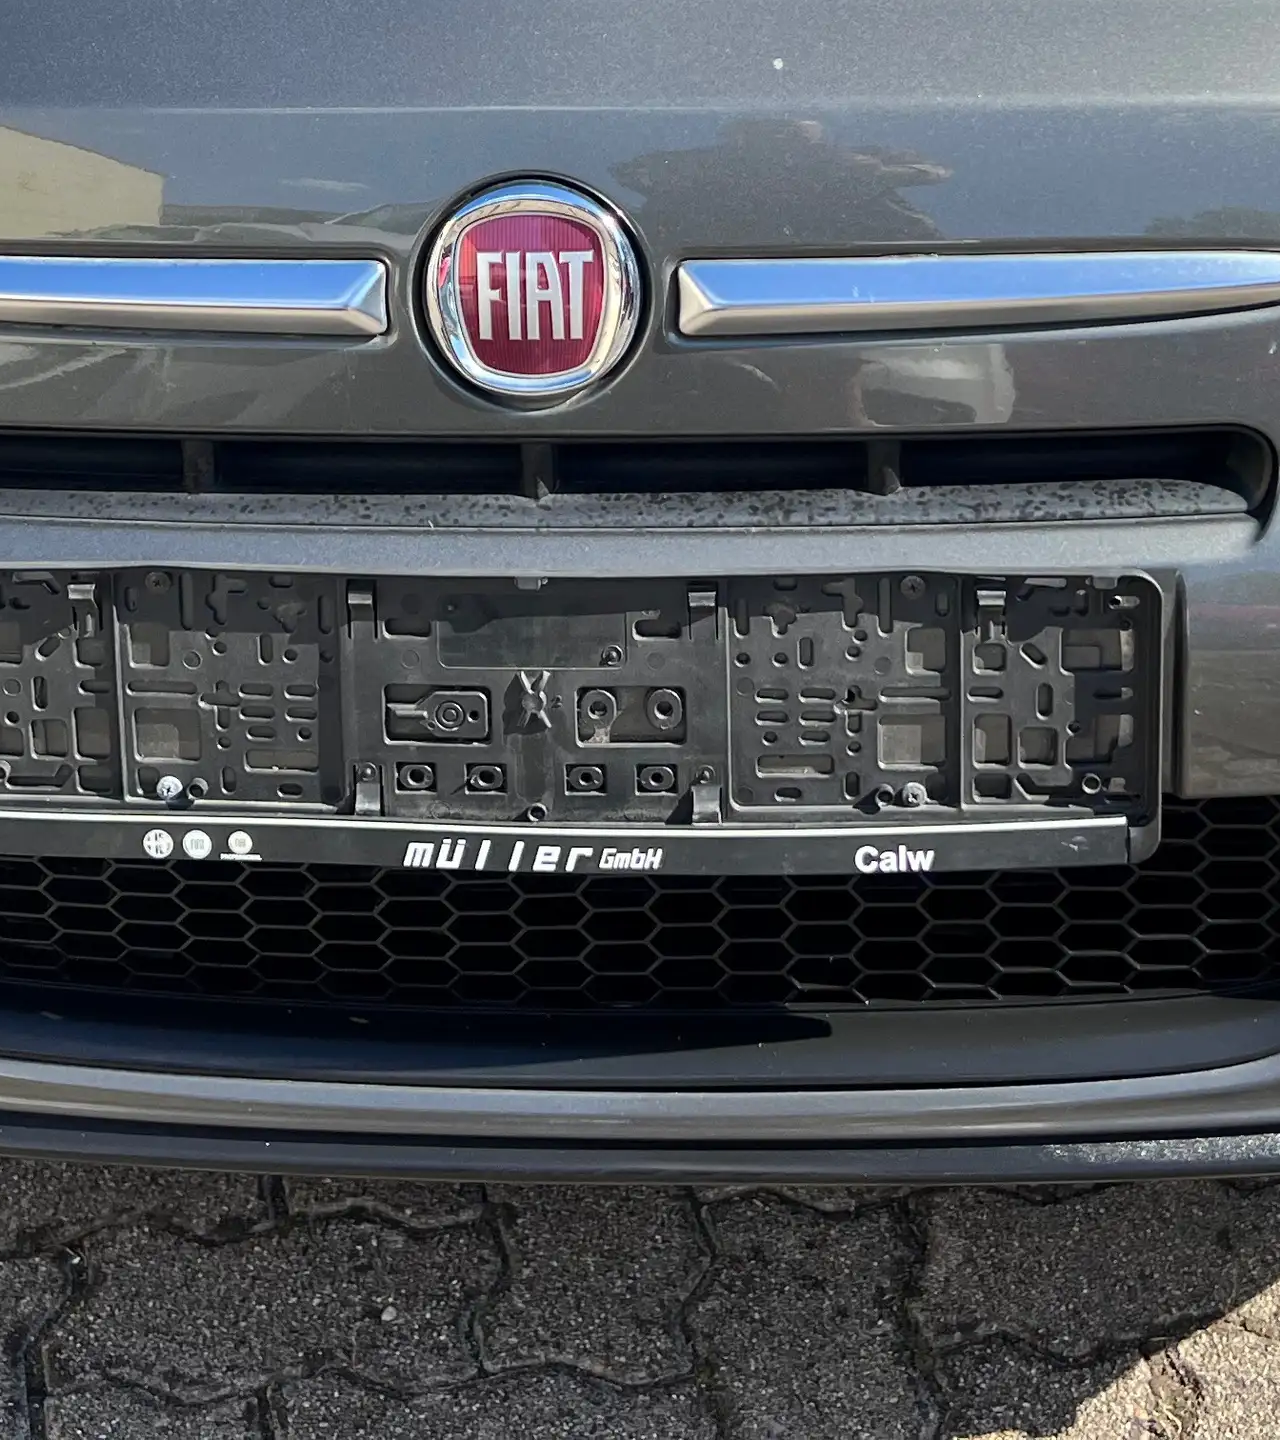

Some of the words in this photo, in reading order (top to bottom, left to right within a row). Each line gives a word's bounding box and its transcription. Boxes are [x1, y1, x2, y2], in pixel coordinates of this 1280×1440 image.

[475, 249, 595, 341] FIAT
[403, 838, 594, 872] müller
[598, 847, 663, 870] GmbH
[854, 844, 935, 874] Calw
